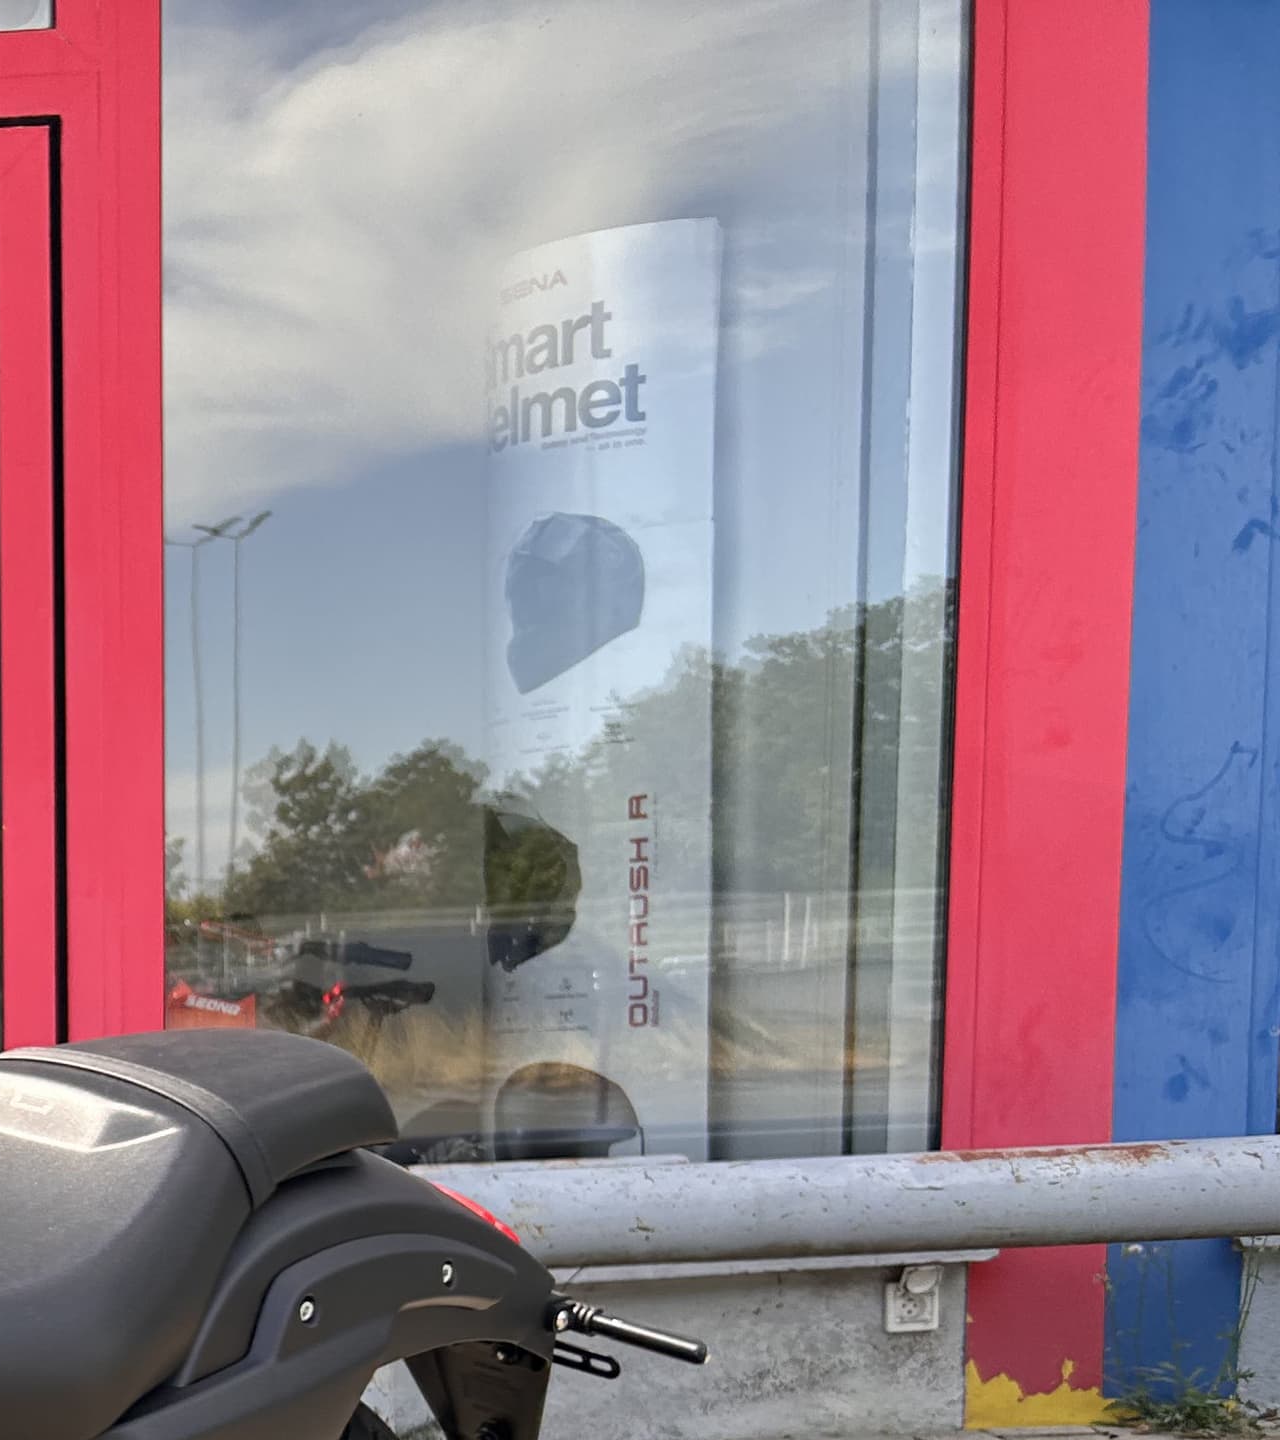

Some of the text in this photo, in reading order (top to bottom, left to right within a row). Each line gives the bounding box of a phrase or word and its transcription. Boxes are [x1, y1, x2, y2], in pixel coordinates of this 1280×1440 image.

[487, 300, 612, 392] mart
[489, 363, 647, 452] elmet
[628, 837, 649, 1028] OUTRUSH
